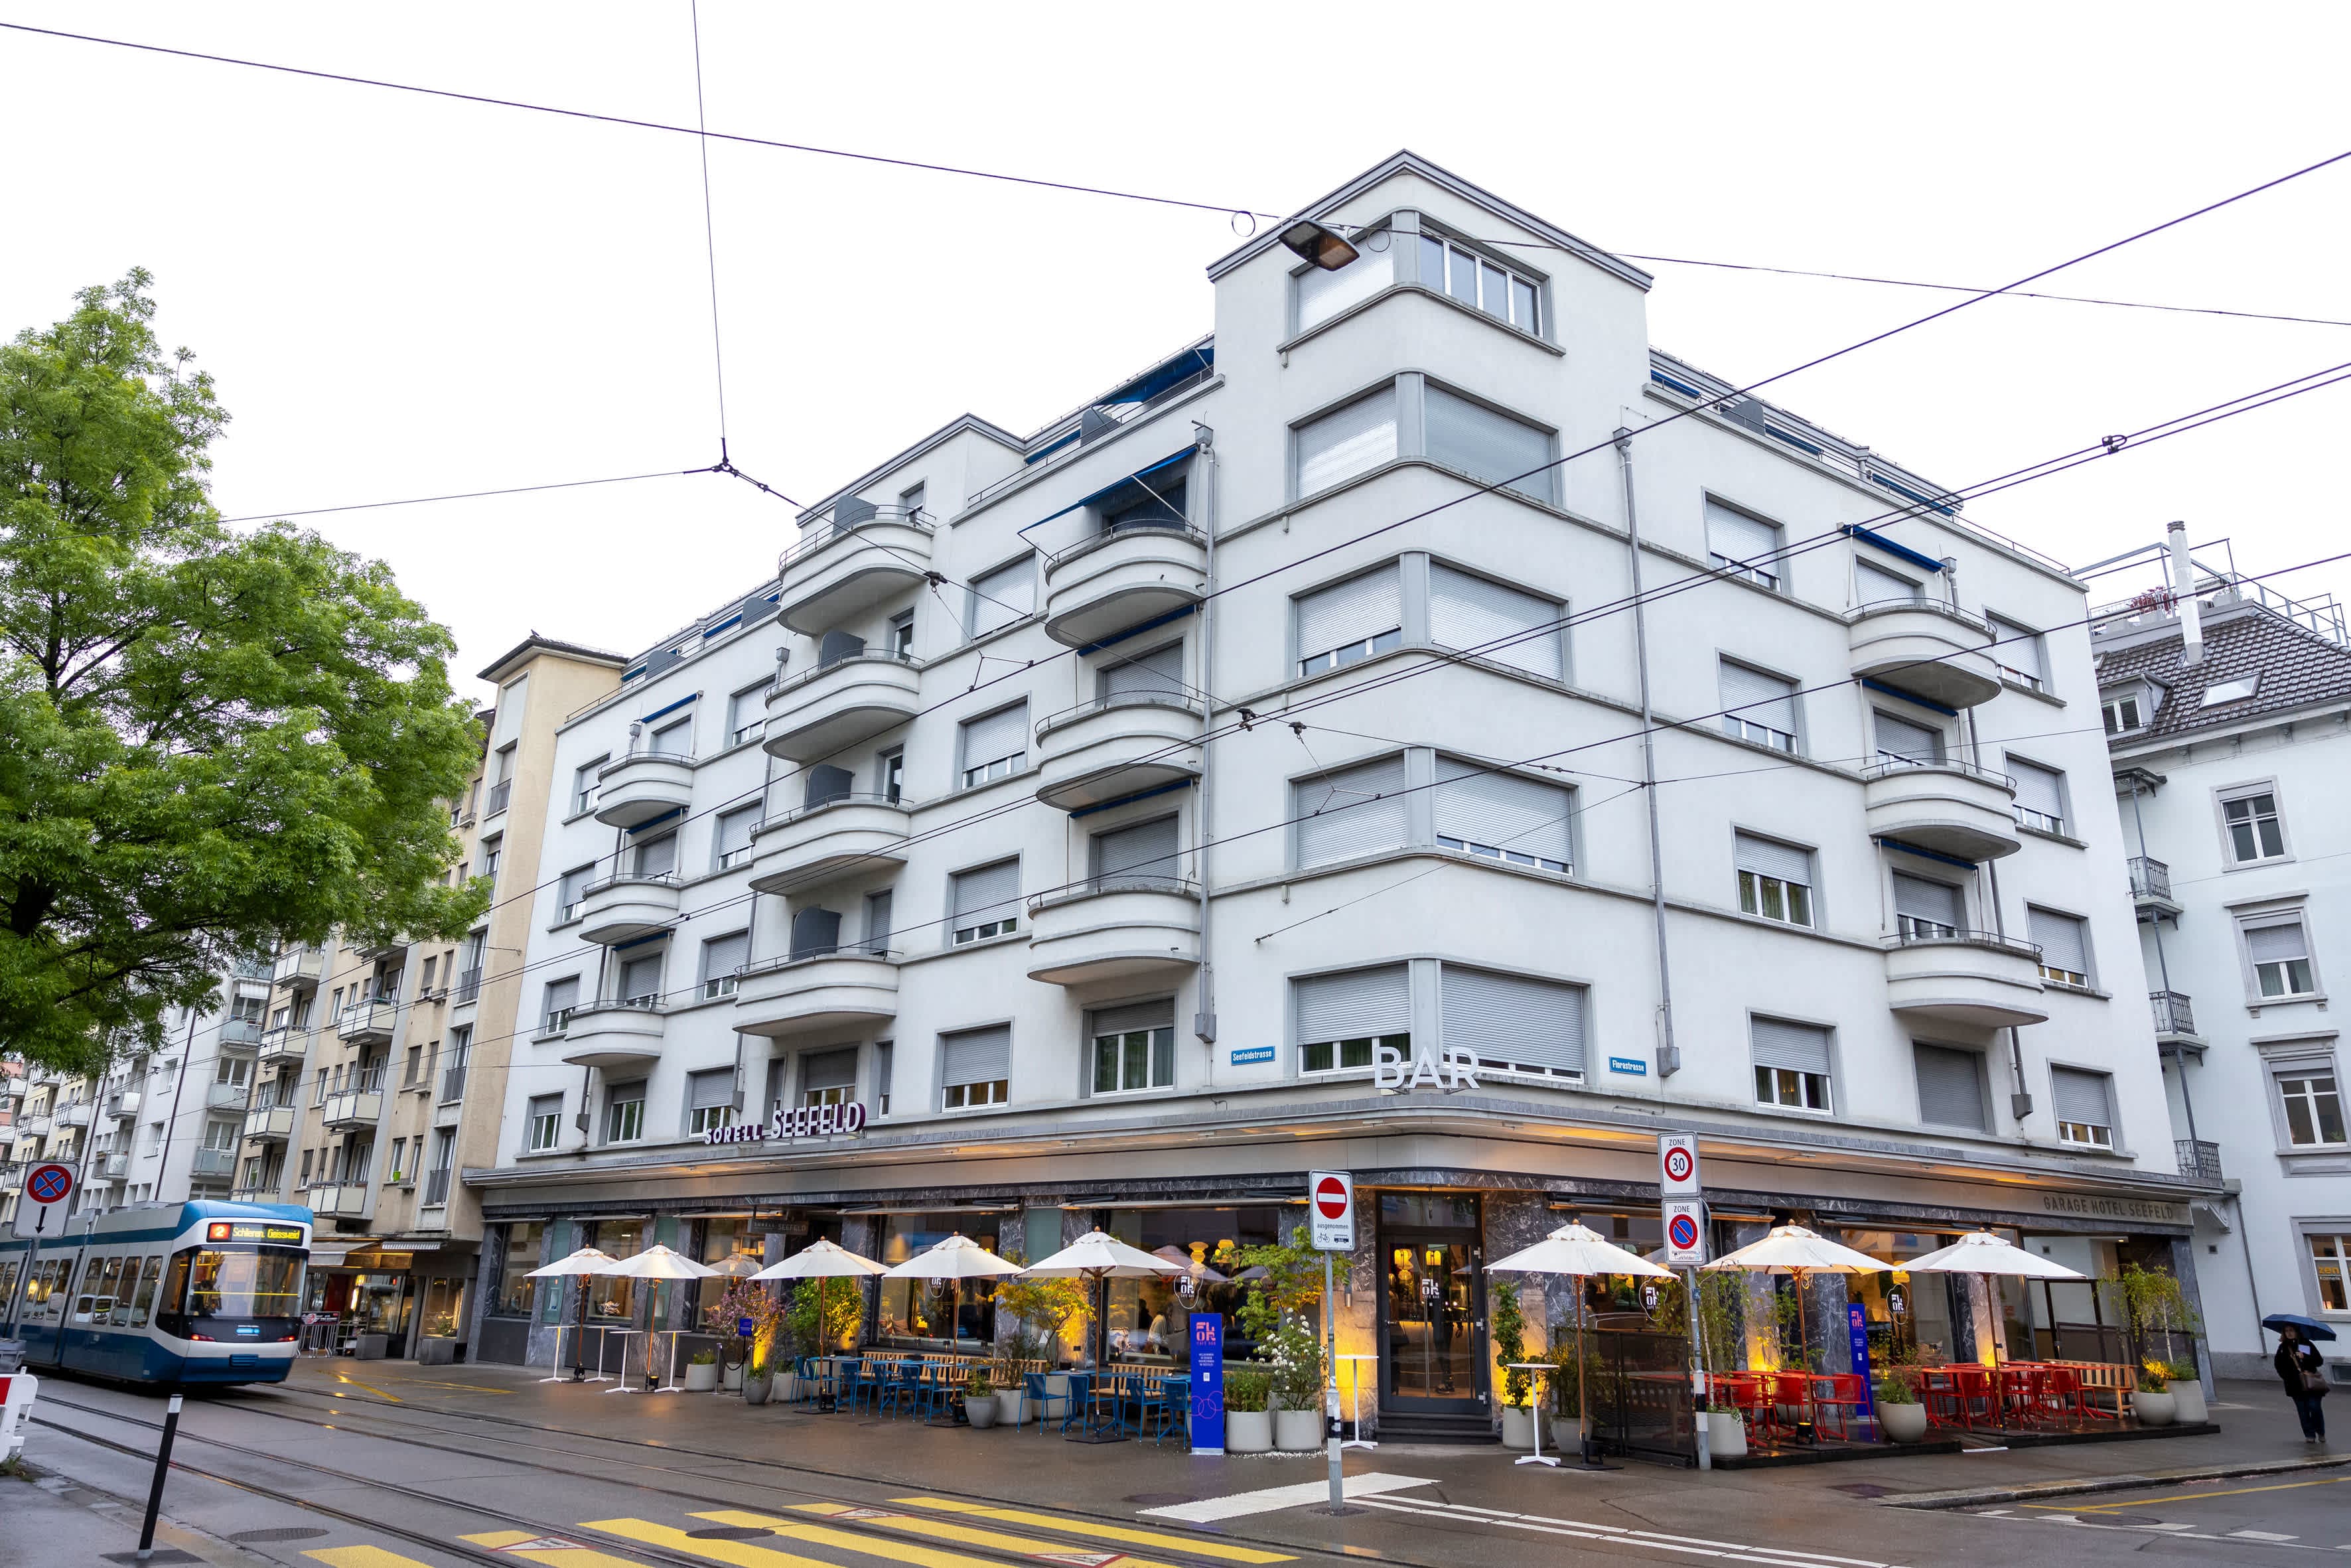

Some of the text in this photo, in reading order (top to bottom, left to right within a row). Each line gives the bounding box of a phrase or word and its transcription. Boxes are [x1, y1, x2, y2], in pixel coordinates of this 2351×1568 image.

[1232, 1050, 1272, 1061] Seefeldstrasse
[1375, 1046, 1480, 1089] BAR
[1612, 1060, 1644, 1072] Florastrasse
[705, 1102, 866, 1145] SORELL SEEFELD
[1672, 1157, 1685, 1171] 30
[2043, 1196, 2173, 1220] GARAGE HOTEL SEEFELD
[214, 1226, 225, 1237] 2
